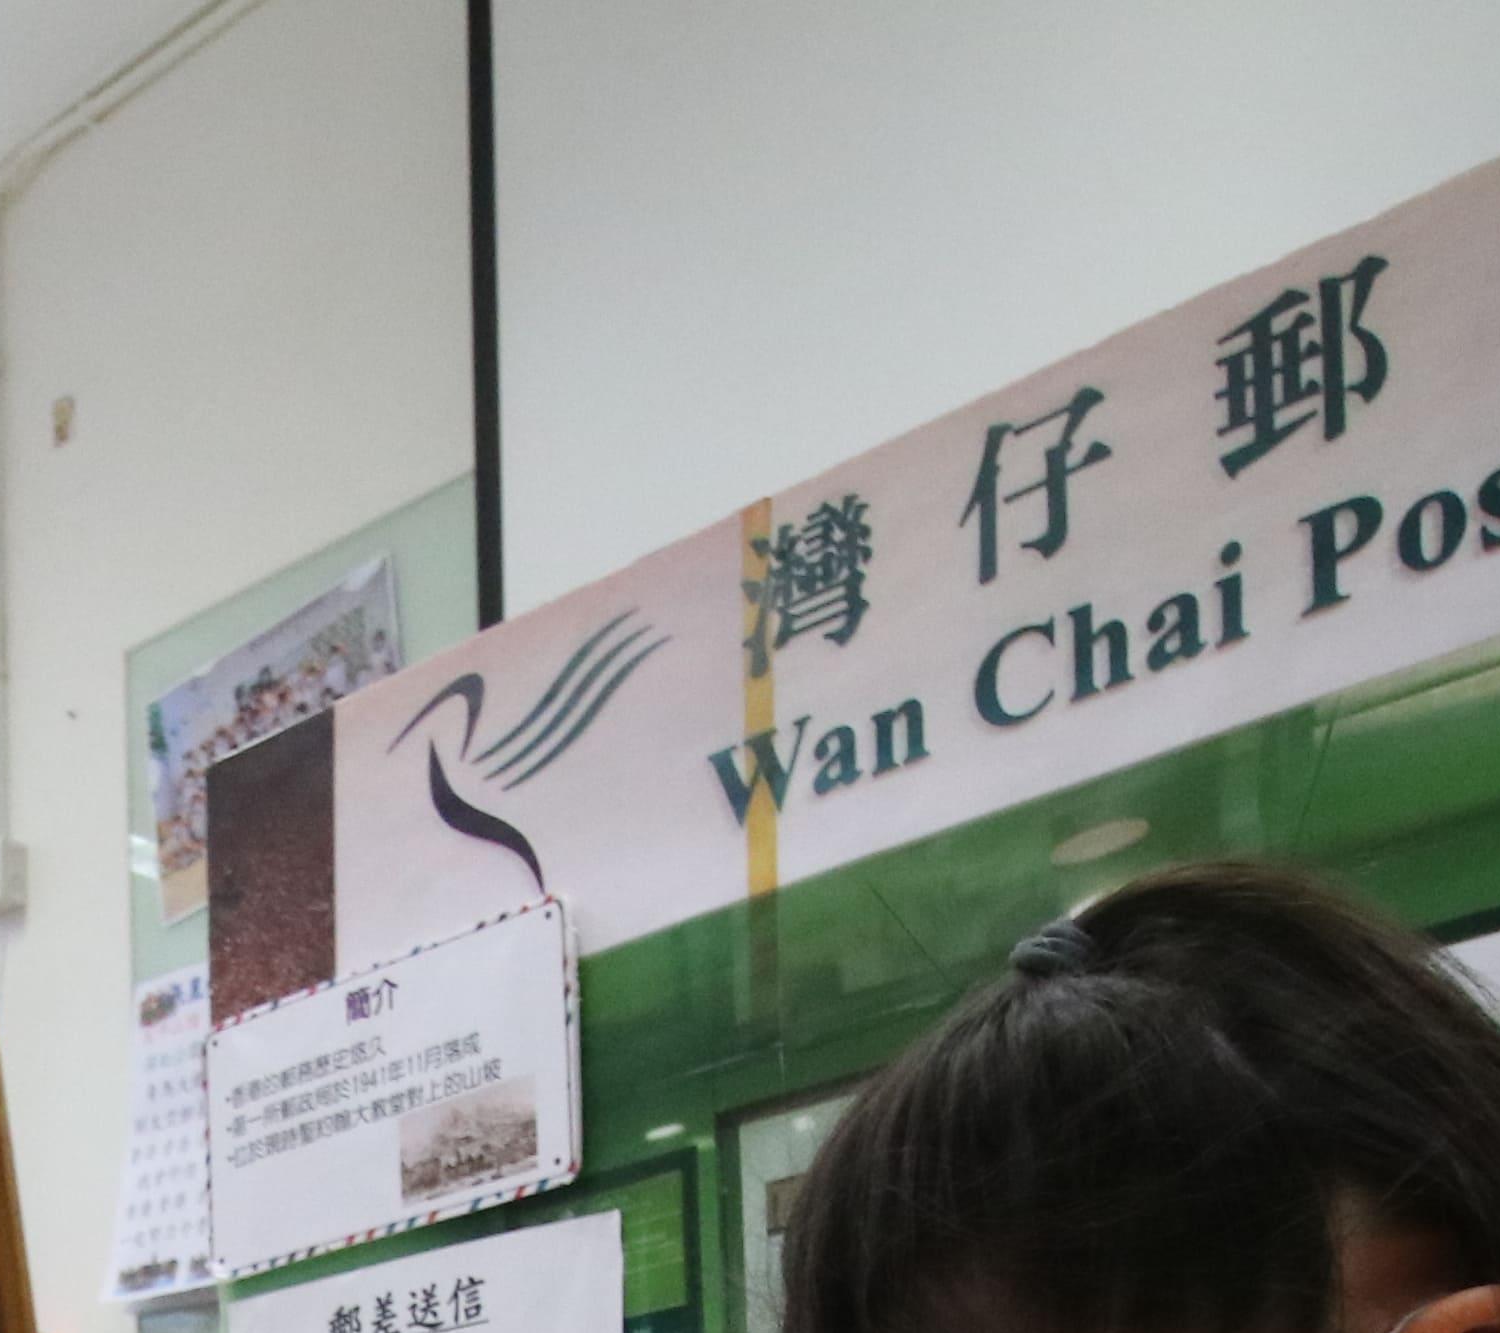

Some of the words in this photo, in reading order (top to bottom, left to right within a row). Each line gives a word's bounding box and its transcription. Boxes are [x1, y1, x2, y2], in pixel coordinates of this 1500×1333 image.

[708, 696, 930, 827] Wan
[974, 539, 1248, 729] Chai
[345, 978, 399, 1024] 簡介
